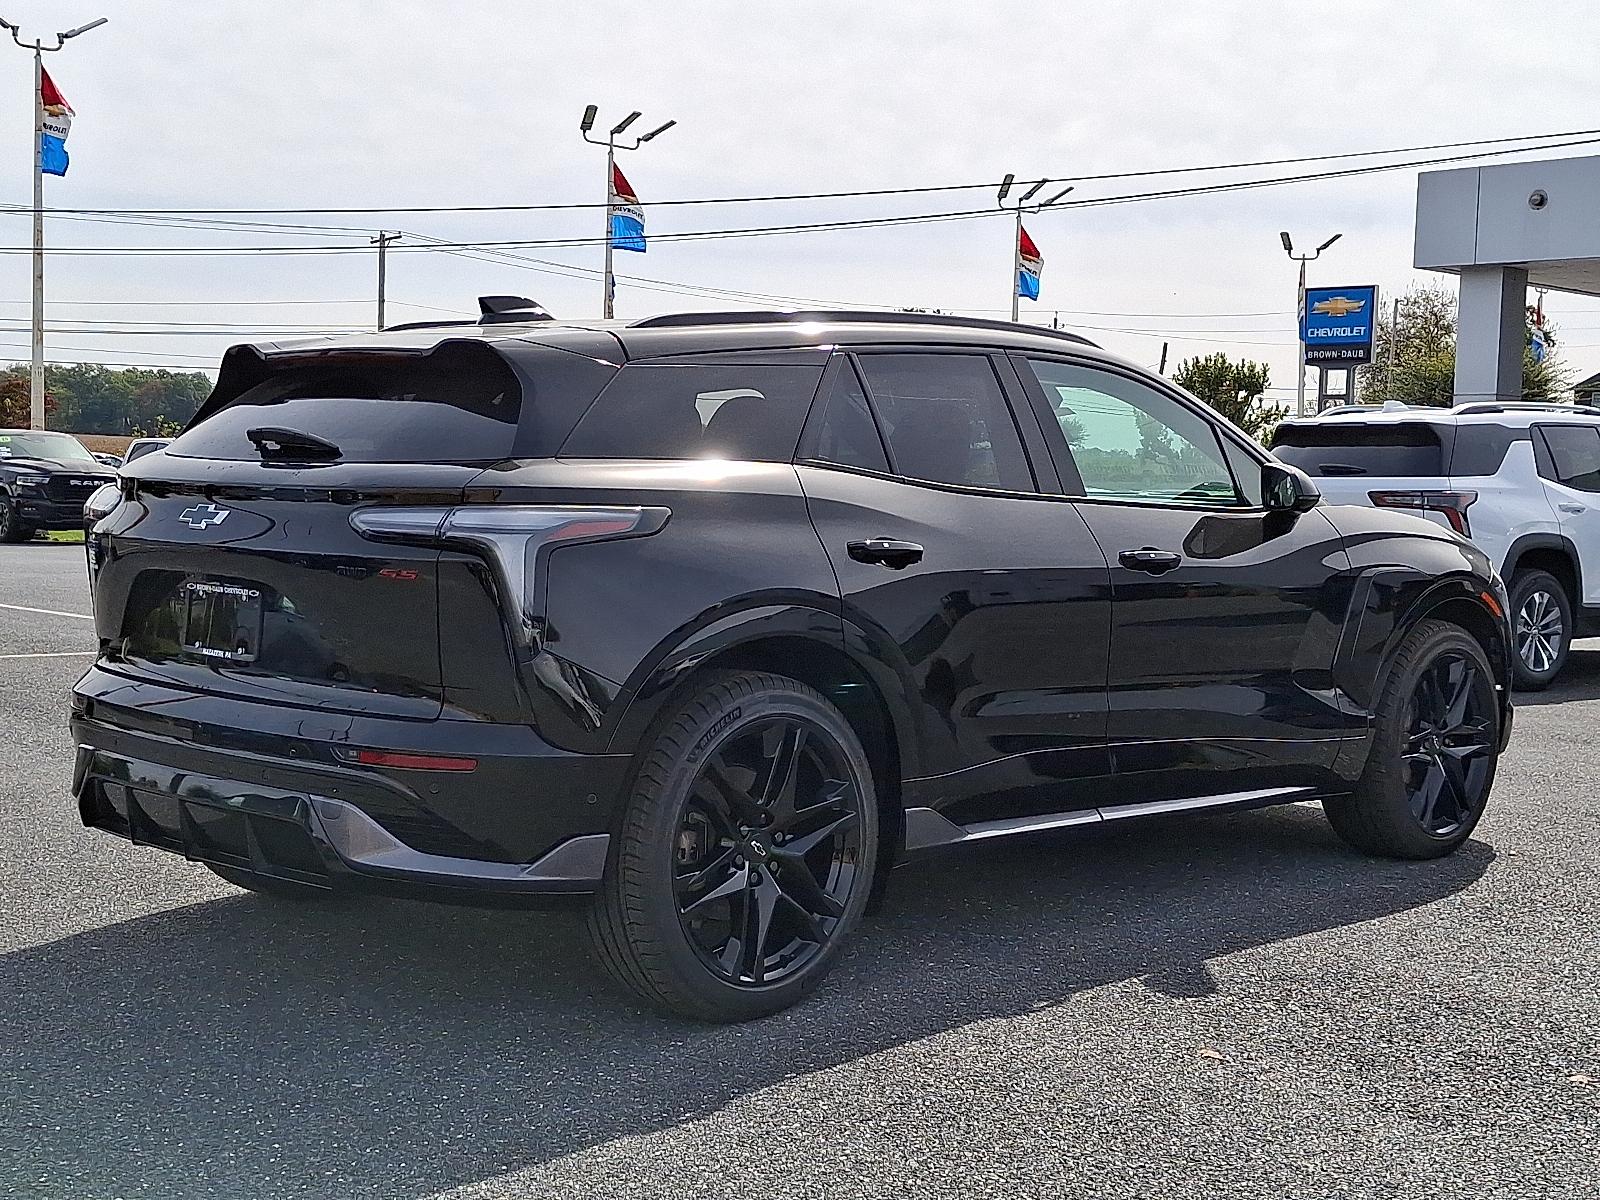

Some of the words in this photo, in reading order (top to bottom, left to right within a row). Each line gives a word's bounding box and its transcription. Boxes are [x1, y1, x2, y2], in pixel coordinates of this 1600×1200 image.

[1307, 326, 1366, 338] CHEVROLET
[1307, 349, 1364, 359] BROWN-DAUB
[699, 708, 741, 750] MICHELIN
